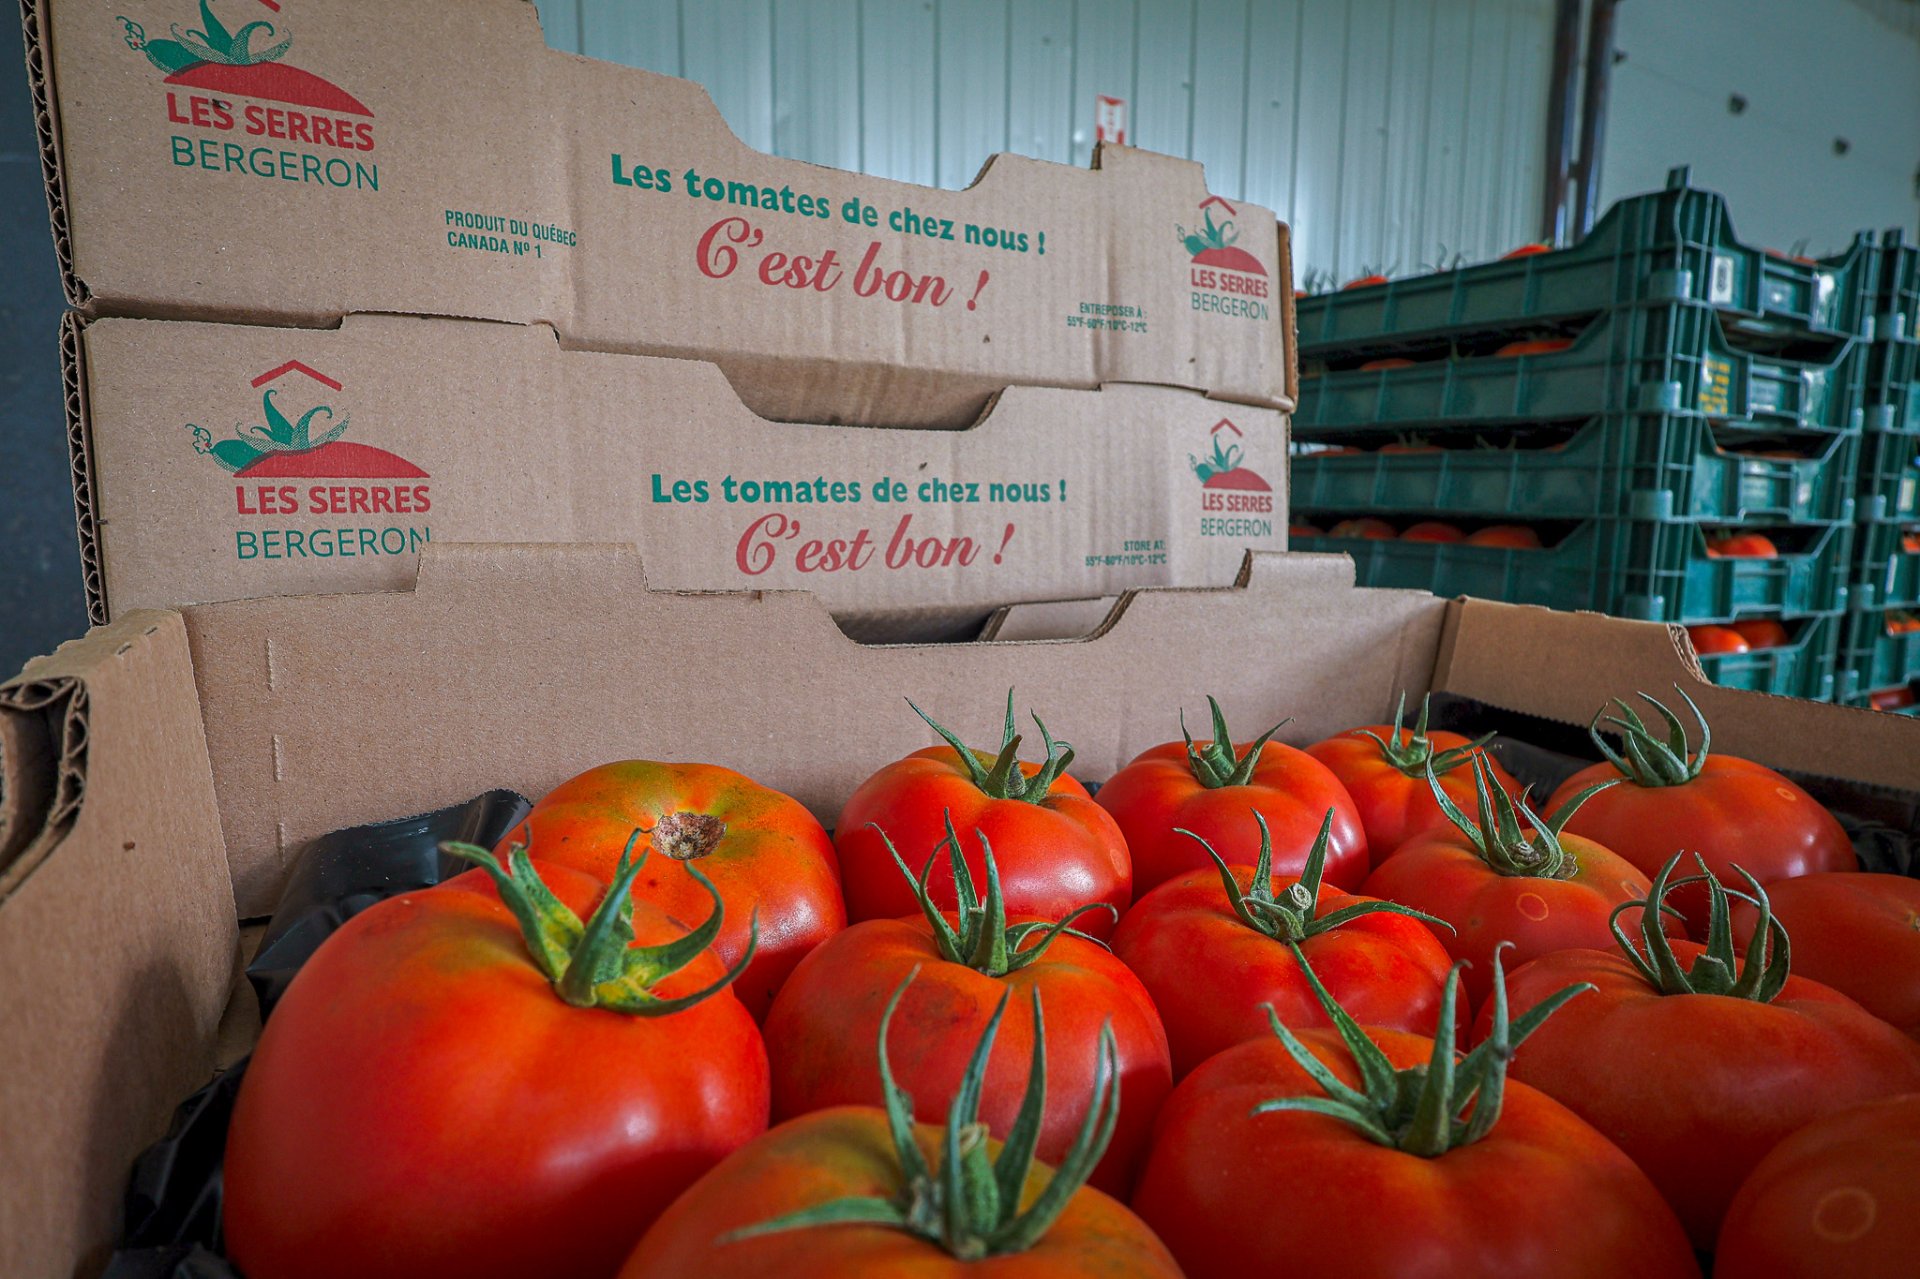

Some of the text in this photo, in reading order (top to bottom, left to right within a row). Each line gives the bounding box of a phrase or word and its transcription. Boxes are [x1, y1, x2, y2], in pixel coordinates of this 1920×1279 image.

[165, 92, 375, 151] LES SERRES
[170, 135, 379, 191] BERGERON
[611, 153, 672, 192] Les
[683, 168, 830, 219] tomates
[841, 197, 878, 227] de
[889, 206, 955, 241] chez
[445, 209, 577, 247] PRODUIT DU QUÉBEC
[447, 231, 509, 253] CANADA
[534, 244, 541, 258] 1
[1191, 268, 1269, 299] LES SERRES
[1080, 302, 1135, 318] ENTREPOSER
[1191, 292, 1269, 321] BERGERON
[235, 485, 431, 515] LES SERRES
[651, 474, 709, 503] Les
[721, 475, 861, 503] tomates
[872, 476, 908, 503] de
[918, 477, 980, 503] chez
[1202, 492, 1273, 513] LES SERRES
[1201, 518, 1272, 537] BERGERON
[235, 527, 431, 560] BERGERON
[1124, 541, 1151, 551] STORE
